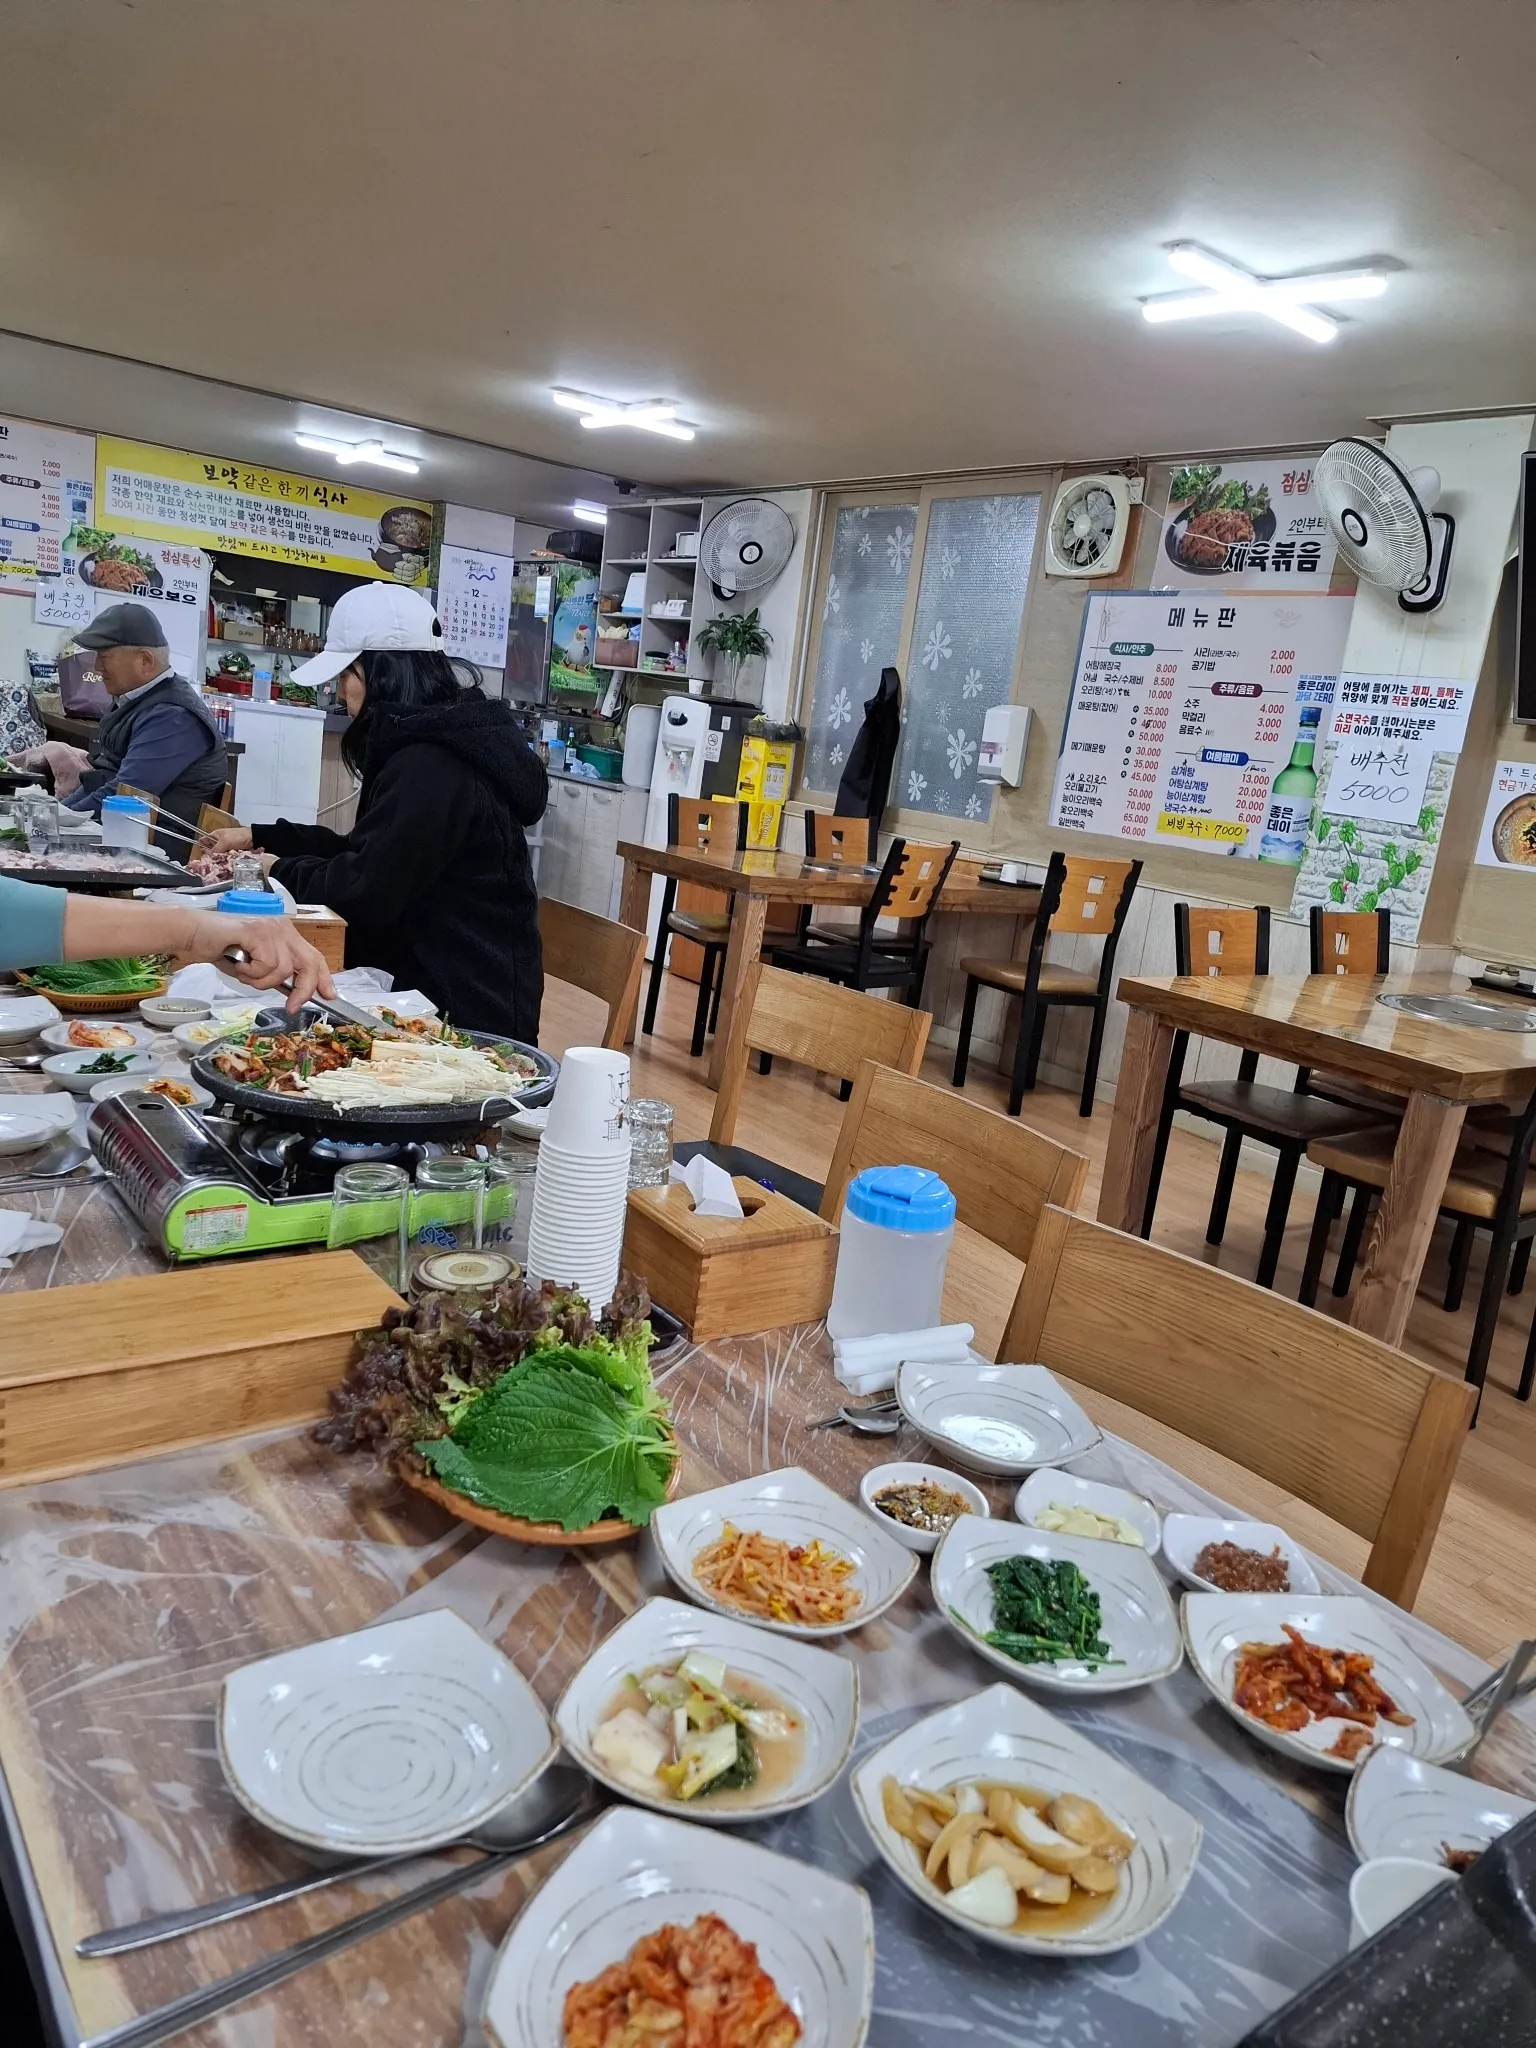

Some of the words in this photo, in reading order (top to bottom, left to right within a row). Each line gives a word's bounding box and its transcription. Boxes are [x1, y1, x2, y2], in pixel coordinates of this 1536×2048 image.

[113, 474, 130, 486] 저희
[134, 478, 180, 496] 어매운탕은
[184, 488, 202, 500] 순수
[205, 491, 232, 506] 국내산
[235, 497, 262, 512] 재료만
[265, 504, 310, 521] 사용합니다.
[112, 486, 130, 498] 각종
[134, 490, 153, 502] 한약
[157, 495, 184, 508] 재료와
[188, 501, 215, 514] 신선한
[267, 516, 293, 529] 생선의
[296, 520, 312, 532] 비린
[314, 525, 330, 537] 맛을
[112, 498, 133, 511] 30여
[137, 502, 154, 515] 시간
[158, 507, 176, 518] 동안
[210, 516, 227, 528] 달여
[230, 520, 247, 532] 보약
[250, 524, 267, 536] 같은
[270, 527, 296, 541] 육수를
[161, 550, 200, 569] 점심특선
[1222, 541, 1322, 572] 제육볶음
[472, 589, 479, 597] 12
[1115, 644, 1146, 654] 식사/안주
[1271, 650, 1295, 660] 2,000
[1086, 661, 1121, 671] 어탕해장국
[1156, 664, 1177, 673] 8,000
[1191, 661, 1216, 672] 공기밥
[1269, 664, 1292, 674] 1,000
[1104, 674, 1144, 685] 국수/수제비
[1154, 677, 1175, 686] 8,500
[1297, 681, 1335, 692] 좋은데이
[1148, 690, 1172, 699] 10,000
[1219, 684, 1255, 695] 주류/음료
[1344, 681, 1370, 692] 어탕에
[1373, 683, 1408, 695] 들어가는
[1314, 693, 1334, 703] ZERO
[1341, 692, 1368, 703] 취향에
[1371, 694, 1389, 705] 맞게
[1144, 706, 1169, 716] 35,000
[1184, 699, 1200, 708] 소주
[1260, 704, 1284, 714] 4,000
[1182, 712, 1206, 722] 막걸리
[1257, 718, 1282, 728] 3,000
[1336, 713, 1379, 726] 소면국수를
[1139, 732, 1164, 742] 50,000
[1179, 725, 1202, 736] 음료수
[1255, 732, 1278, 742] 2,000
[1334, 724, 1351, 734] 미리
[1354, 726, 1380, 737] 이야기
[1384, 727, 1422, 740] 해주세요.
[1071, 742, 1106, 754] 메기매운탕
[1136, 747, 1161, 757] 30,000
[1133, 759, 1158, 770] 35,000
[1206, 752, 1239, 764] 여름별미
[1351, 750, 1409, 776] 배추전
[1131, 772, 1156, 782] 45,000
[1171, 766, 1196, 777] 삼계탕
[1242, 774, 1270, 785] 13,000
[1064, 781, 1098, 793] 오리불고기
[1128, 788, 1153, 799] 50,000
[1169, 778, 1208, 792] 어탕삼계탕
[1238, 787, 1267, 798] 20,000
[1340, 781, 1409, 803] 5000
[1062, 794, 1102, 807] 능이오리백숙
[1126, 801, 1151, 812] 70,000
[1166, 791, 1206, 804] 능이삼계탕
[1235, 799, 1264, 811] 20,000
[1124, 813, 1148, 824] 65,000
[1164, 802, 1187, 814] 냉국수
[1238, 813, 1262, 824] 6,000
[1270, 805, 1293, 820] 좋은
[1058, 817, 1086, 830] 일반백숙
[1121, 826, 1146, 836] 60,000
[1267, 819, 1290, 833] 데이
